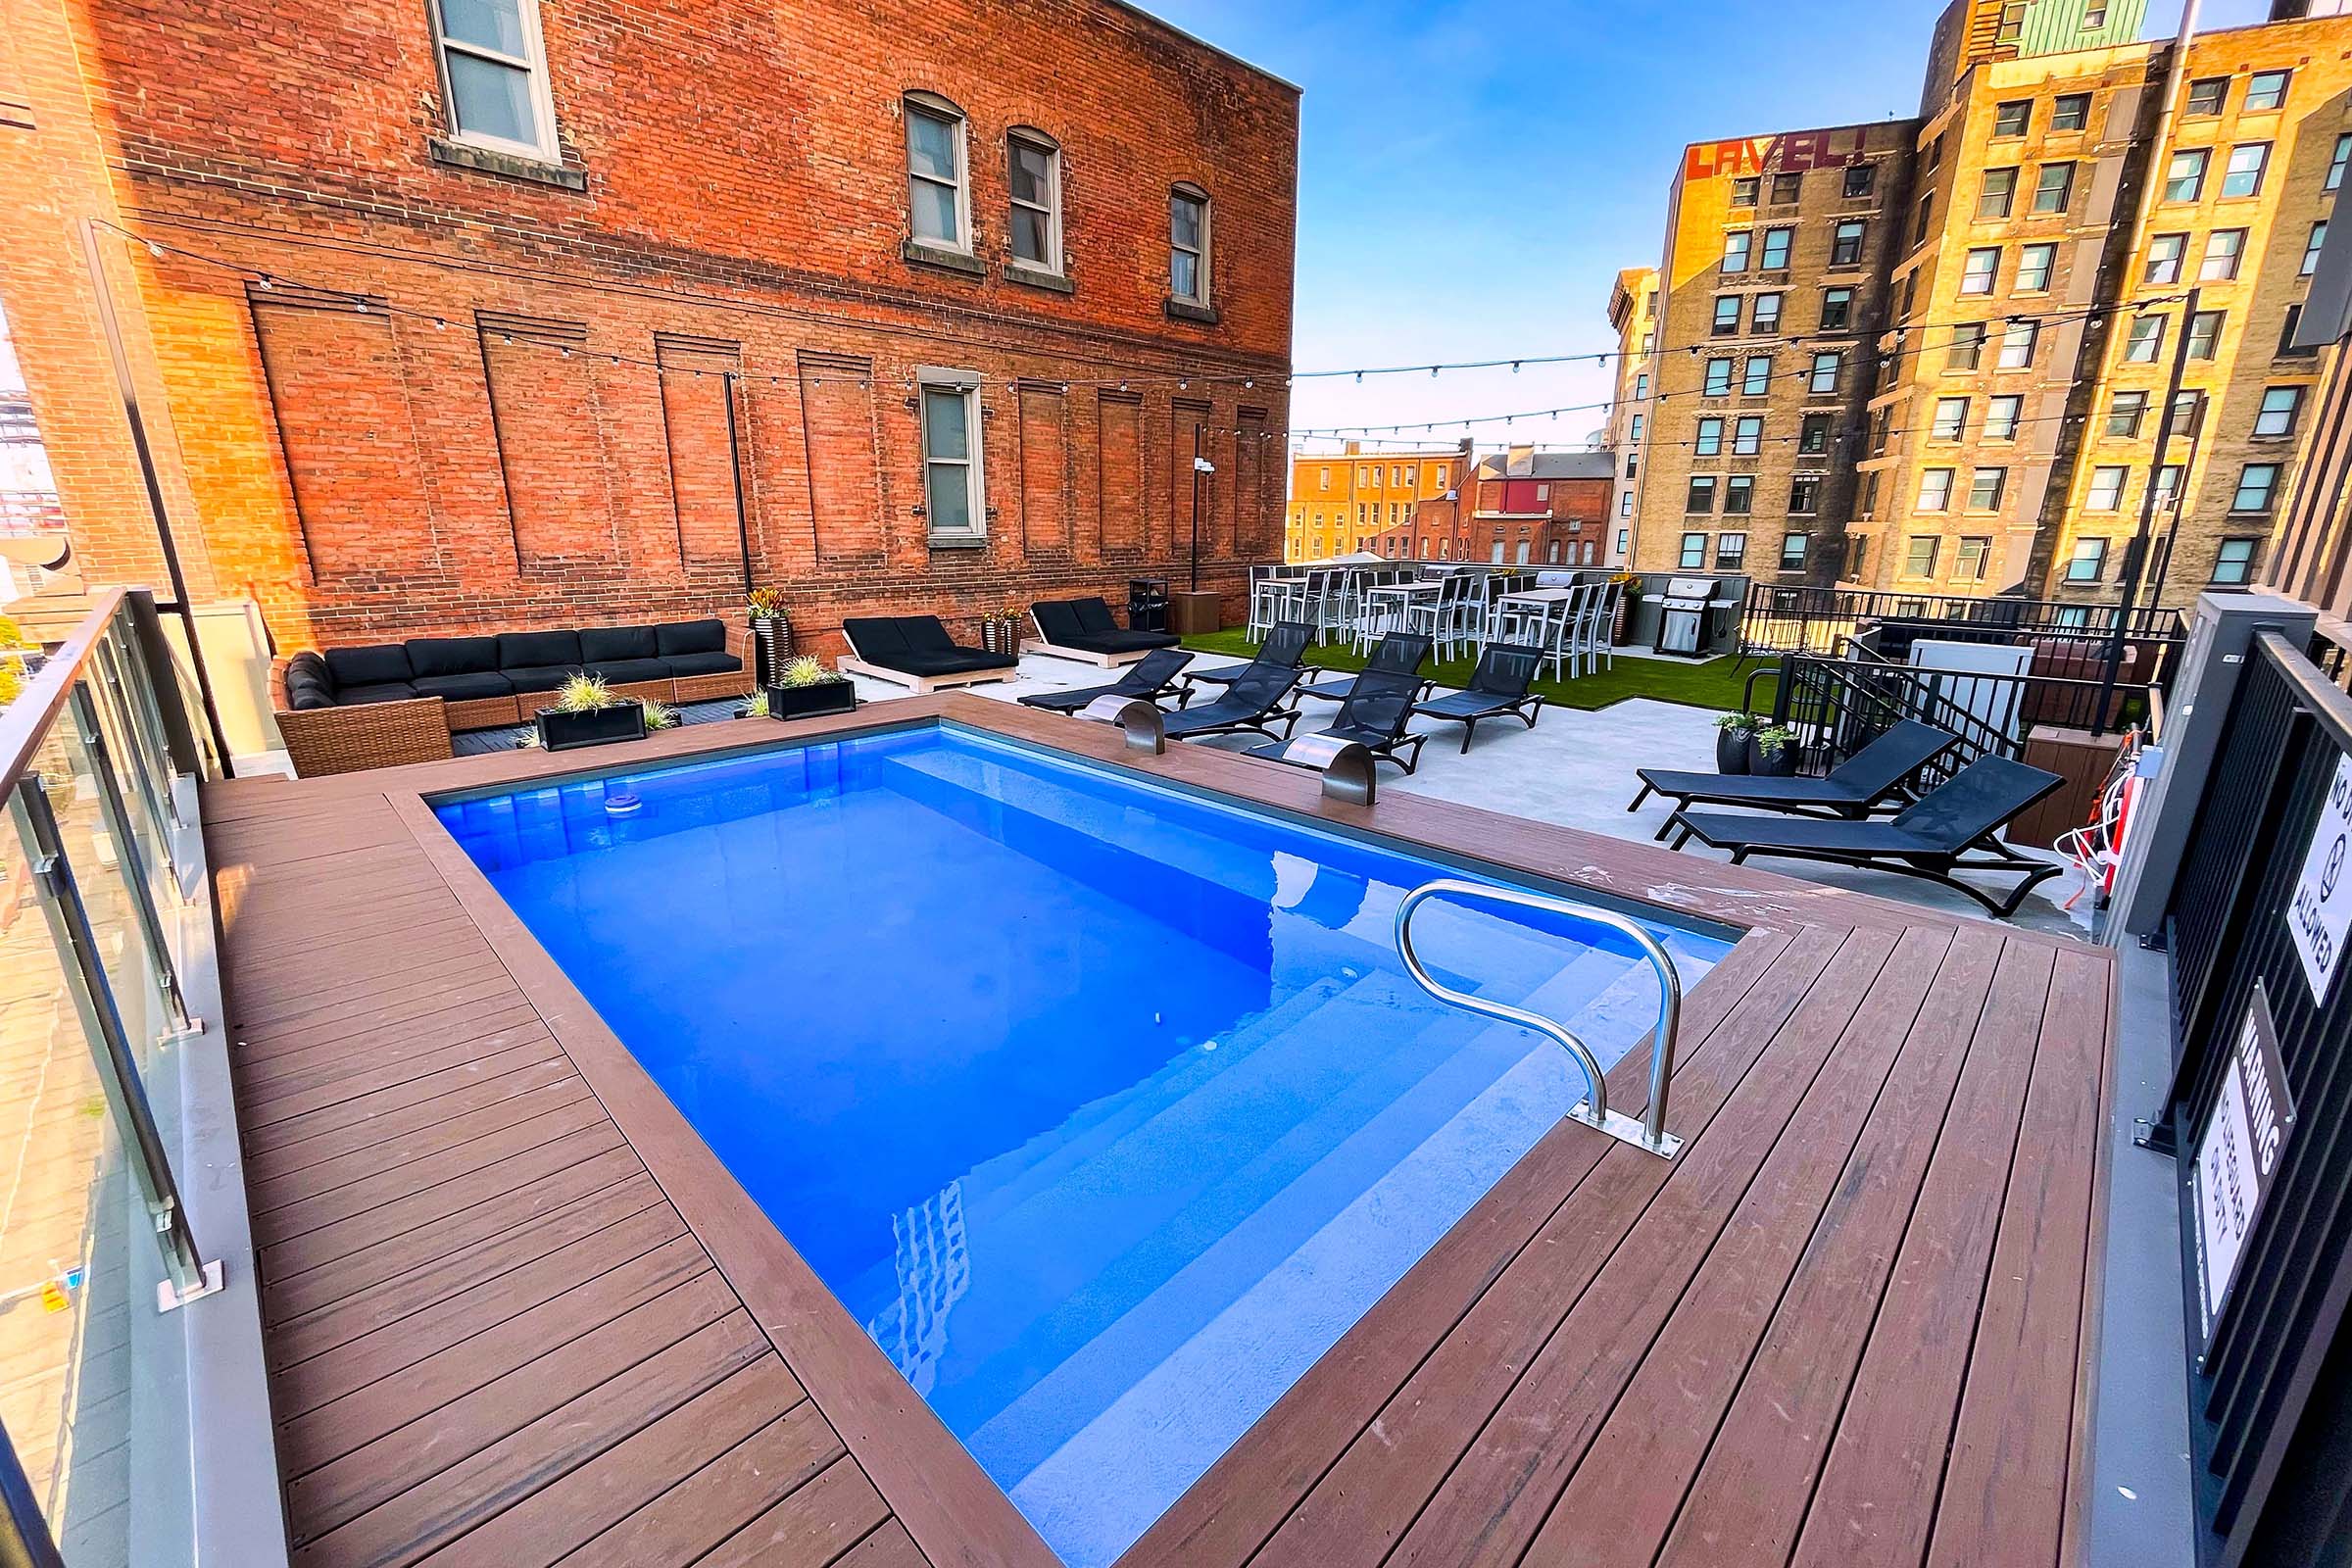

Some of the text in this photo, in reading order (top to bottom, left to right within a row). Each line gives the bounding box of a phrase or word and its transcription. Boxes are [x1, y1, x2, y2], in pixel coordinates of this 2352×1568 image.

[2329, 771, 2347, 809] NO
[2295, 884, 2332, 973] ALLOWED
[2240, 1007, 2279, 1175] WARNING
[2211, 1145, 2228, 1246] ON DUTY
[2223, 1114, 2245, 1241] LIFEGUARD
